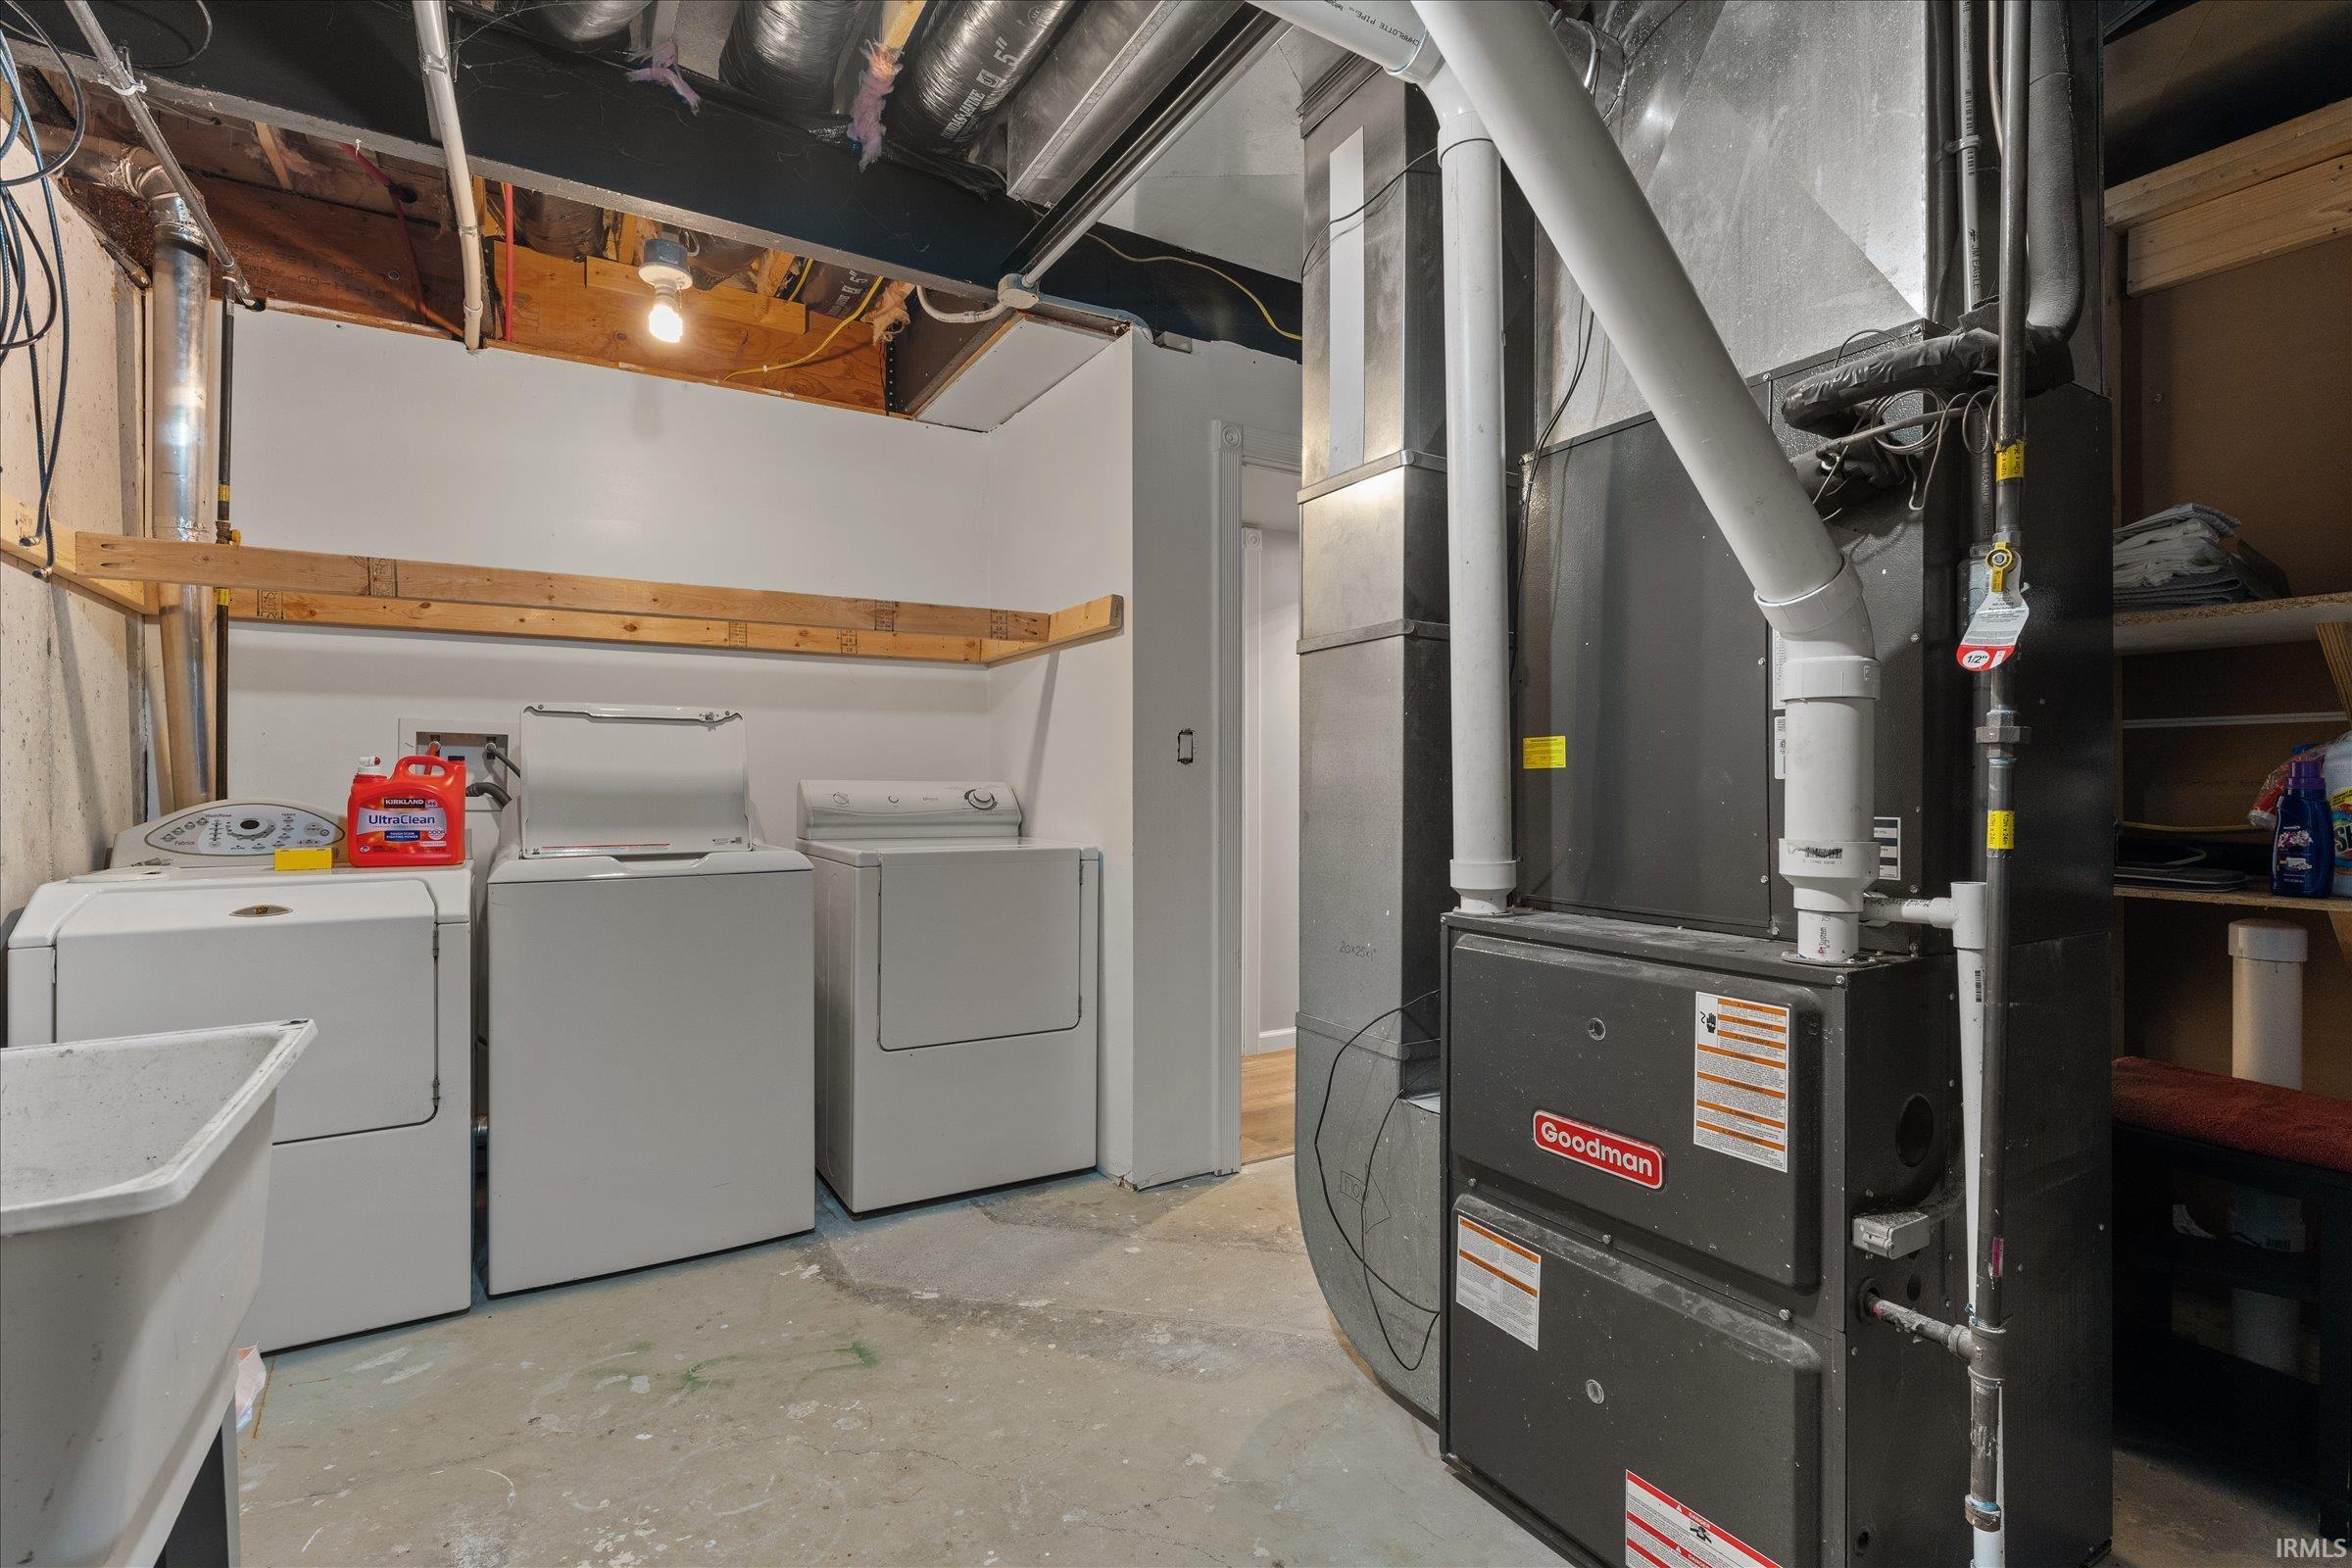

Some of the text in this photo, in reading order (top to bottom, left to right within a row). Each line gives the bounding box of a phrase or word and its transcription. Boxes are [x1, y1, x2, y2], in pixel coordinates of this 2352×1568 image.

[1379, 22, 1420, 46] CHARLOTTE
[1972, 260, 1982, 289] EAGLE
[368, 814, 435, 824] UltraClean
[1541, 1121, 1652, 1177] Goodman
[1689, 1512, 1711, 1530] DANGER
